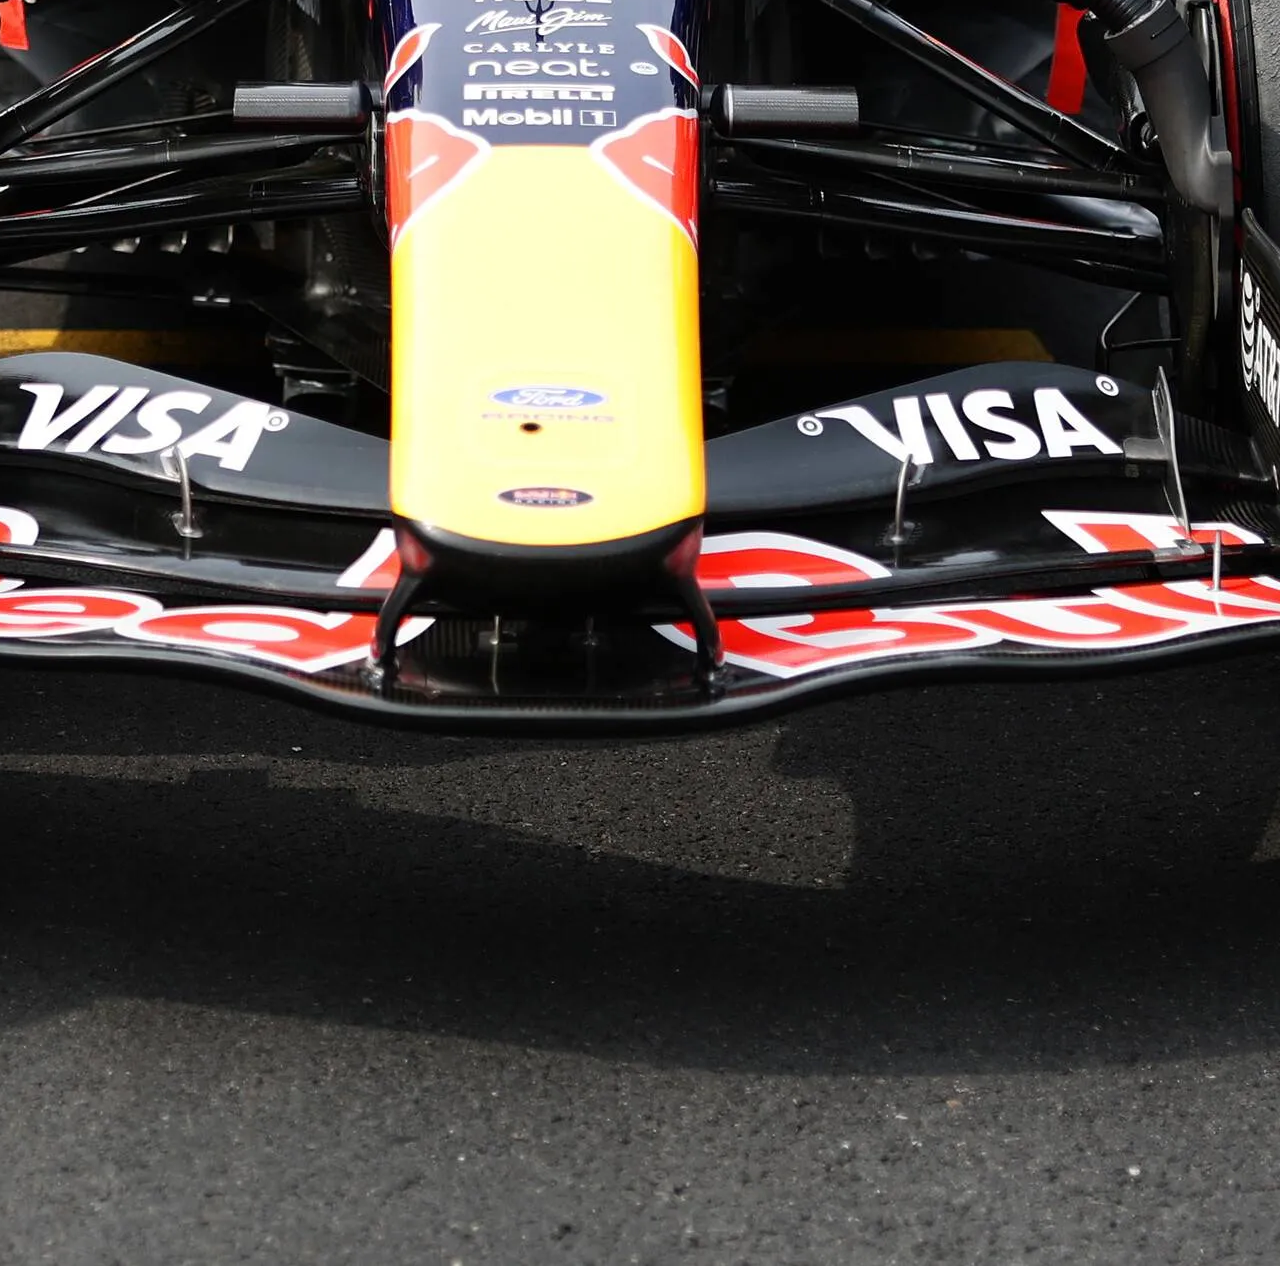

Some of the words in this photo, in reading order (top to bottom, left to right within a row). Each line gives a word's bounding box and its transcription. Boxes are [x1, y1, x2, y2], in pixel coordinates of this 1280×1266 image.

[464, 9, 537, 34] Maui
[536, 7, 613, 36] Jim
[463, 42, 616, 55] CARLYLE
[467, 58, 611, 77] neat.
[463, 83, 616, 102] PIRELLI
[463, 107, 573, 126] Mobil
[17, 381, 271, 472] VISA
[813, 388, 1124, 465] VISA
